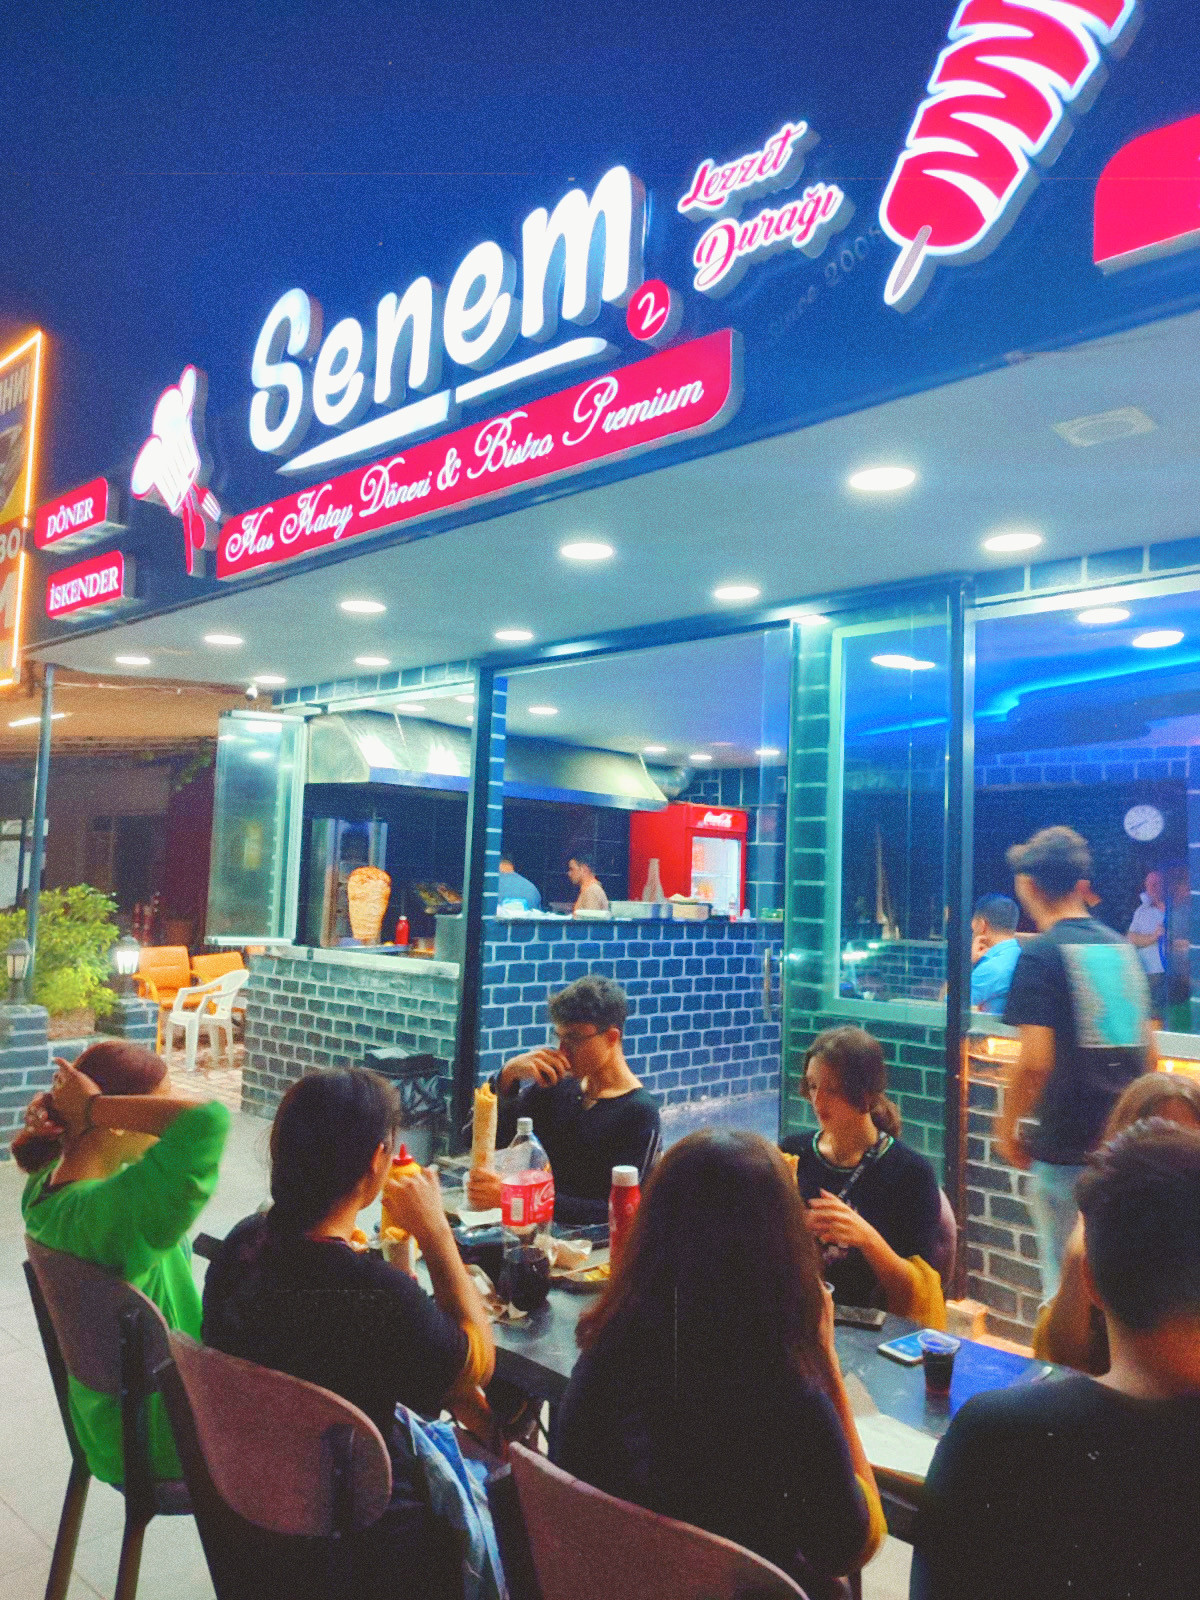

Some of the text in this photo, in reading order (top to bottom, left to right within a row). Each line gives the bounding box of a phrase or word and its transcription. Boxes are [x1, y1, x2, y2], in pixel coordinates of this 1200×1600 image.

[678, 120, 808, 213] Lezzet
[693, 183, 844, 291] Durağı
[249, 165, 632, 452] Senem
[46, 496, 94, 540] DÖNER
[225, 375, 704, 562] Has Hatay Döneri & Bistro Premium
[48, 564, 119, 611] İSKENDER
